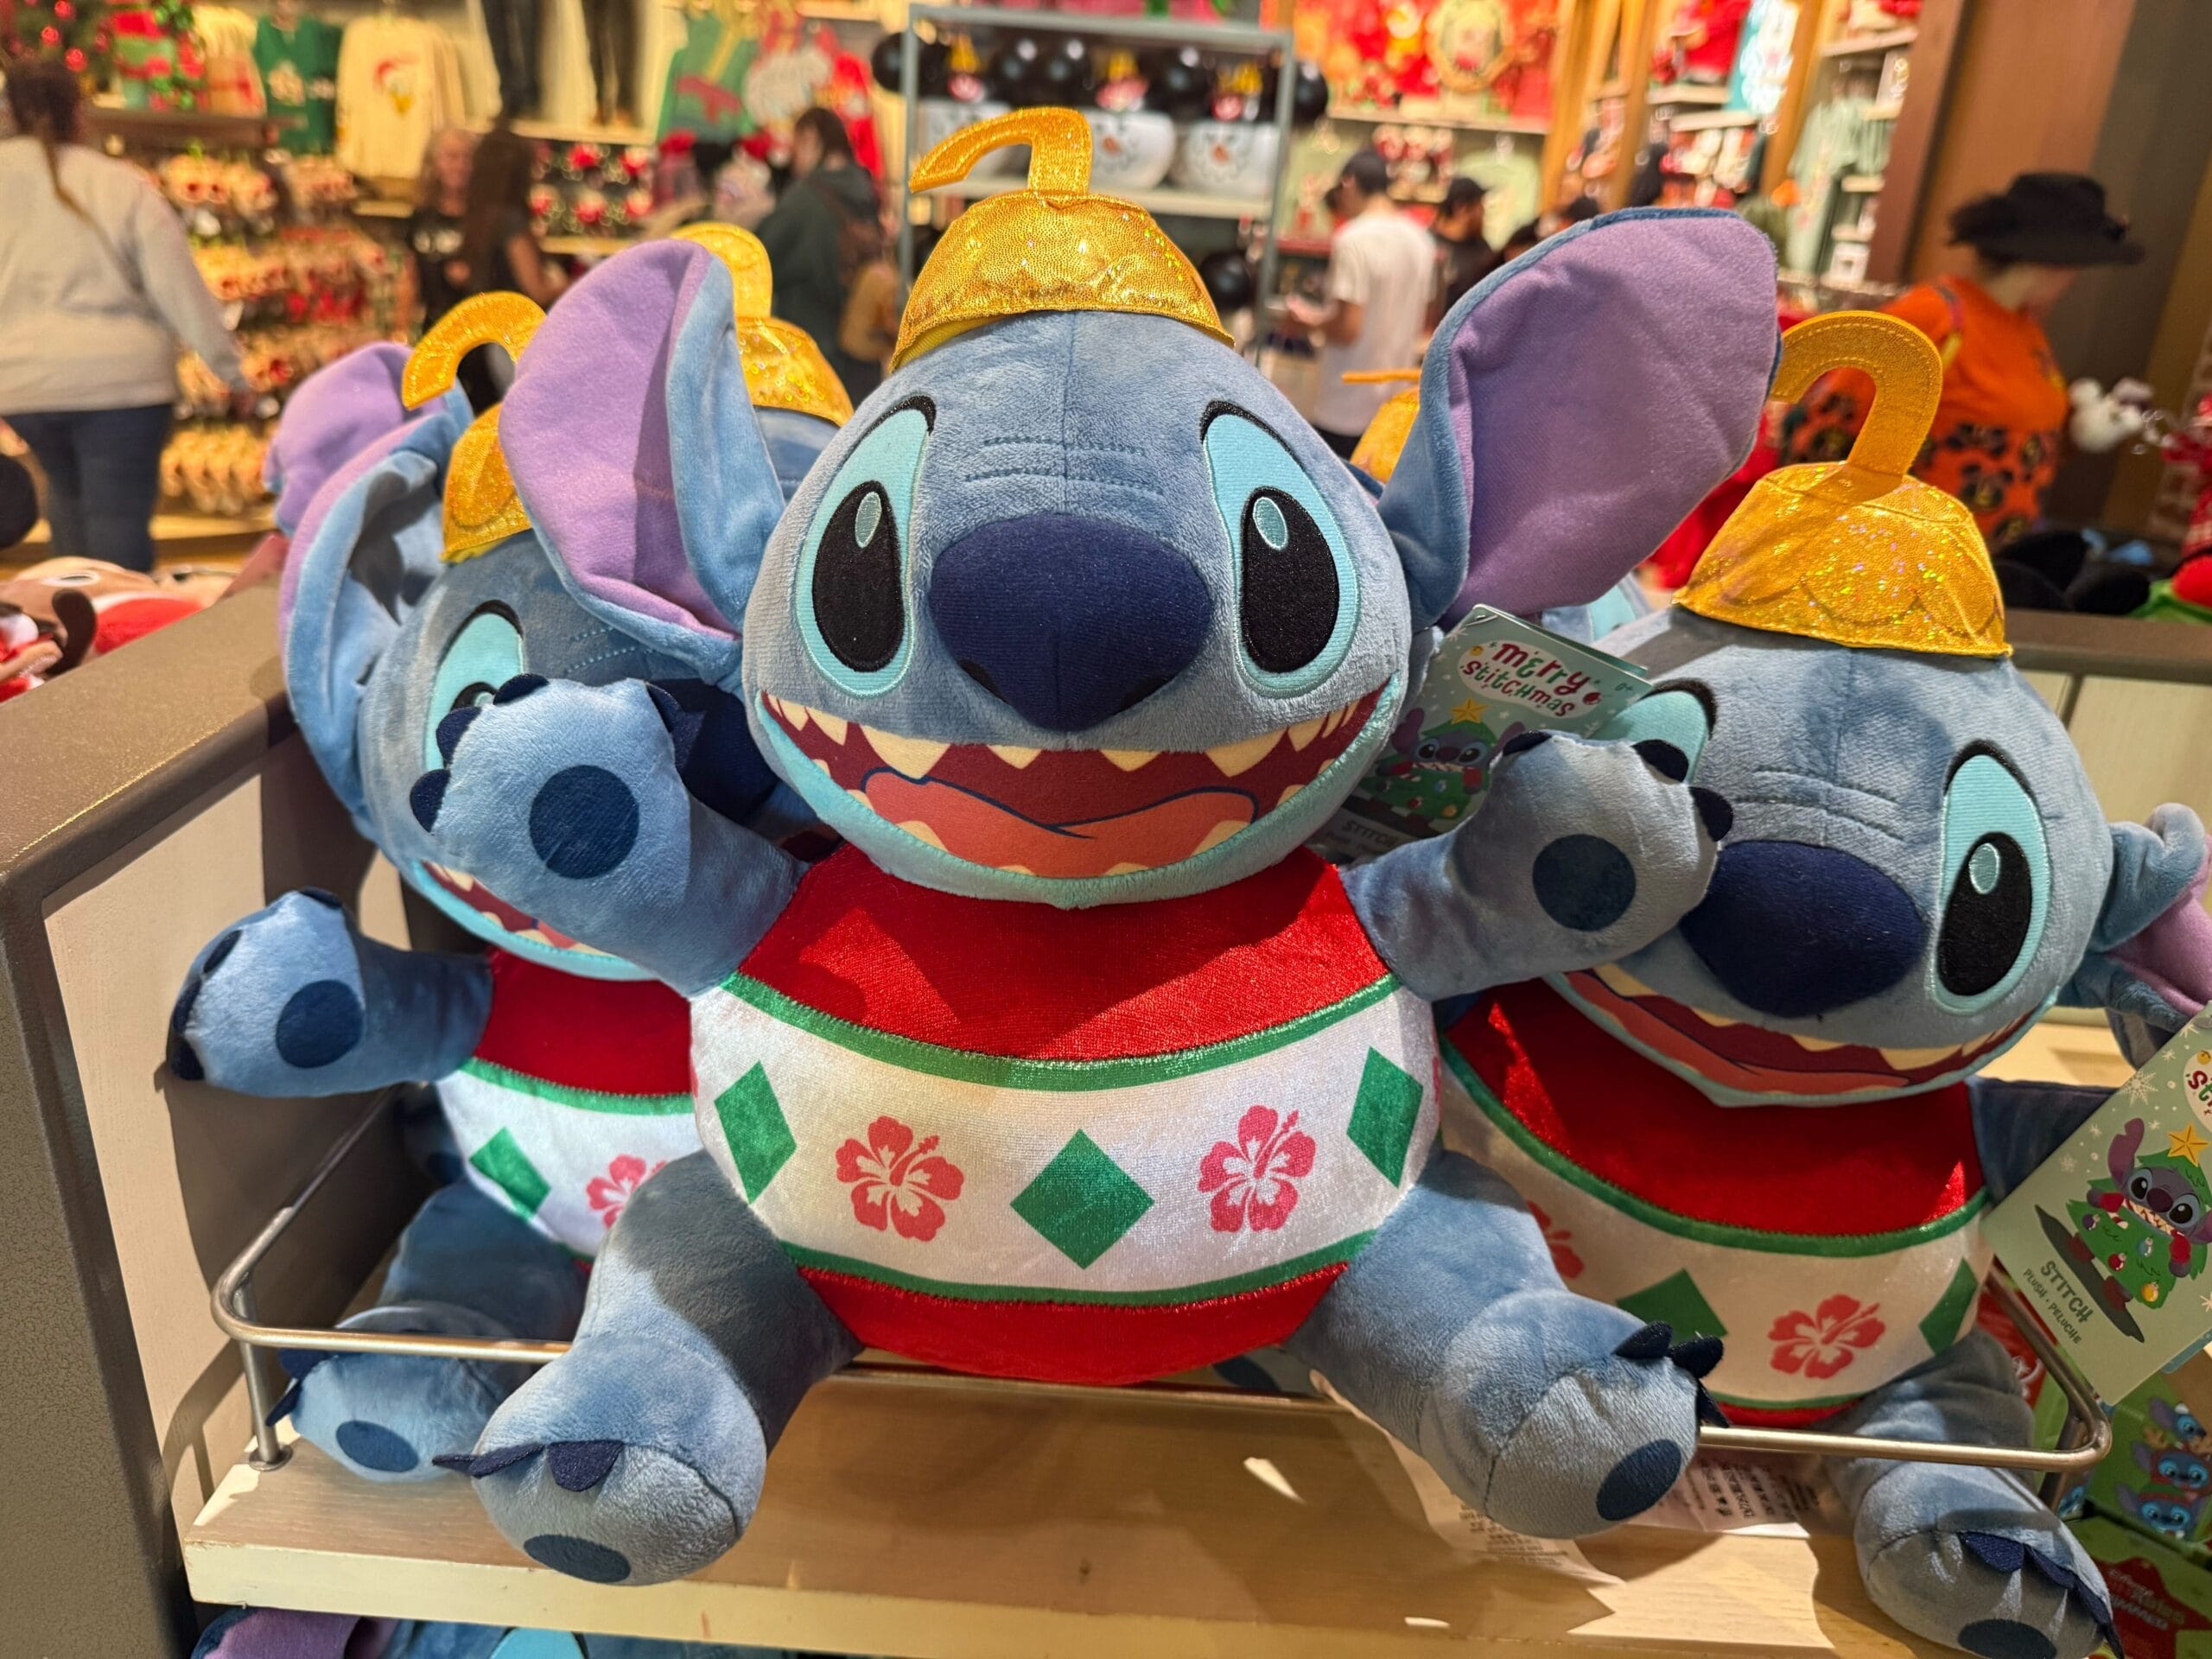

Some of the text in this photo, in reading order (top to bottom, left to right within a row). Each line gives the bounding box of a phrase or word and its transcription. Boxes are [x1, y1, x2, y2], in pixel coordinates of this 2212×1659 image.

[2023, 1268, 2082, 1344] PLUSH PELUCHE
[2040, 1260, 2093, 1323] STITCH
